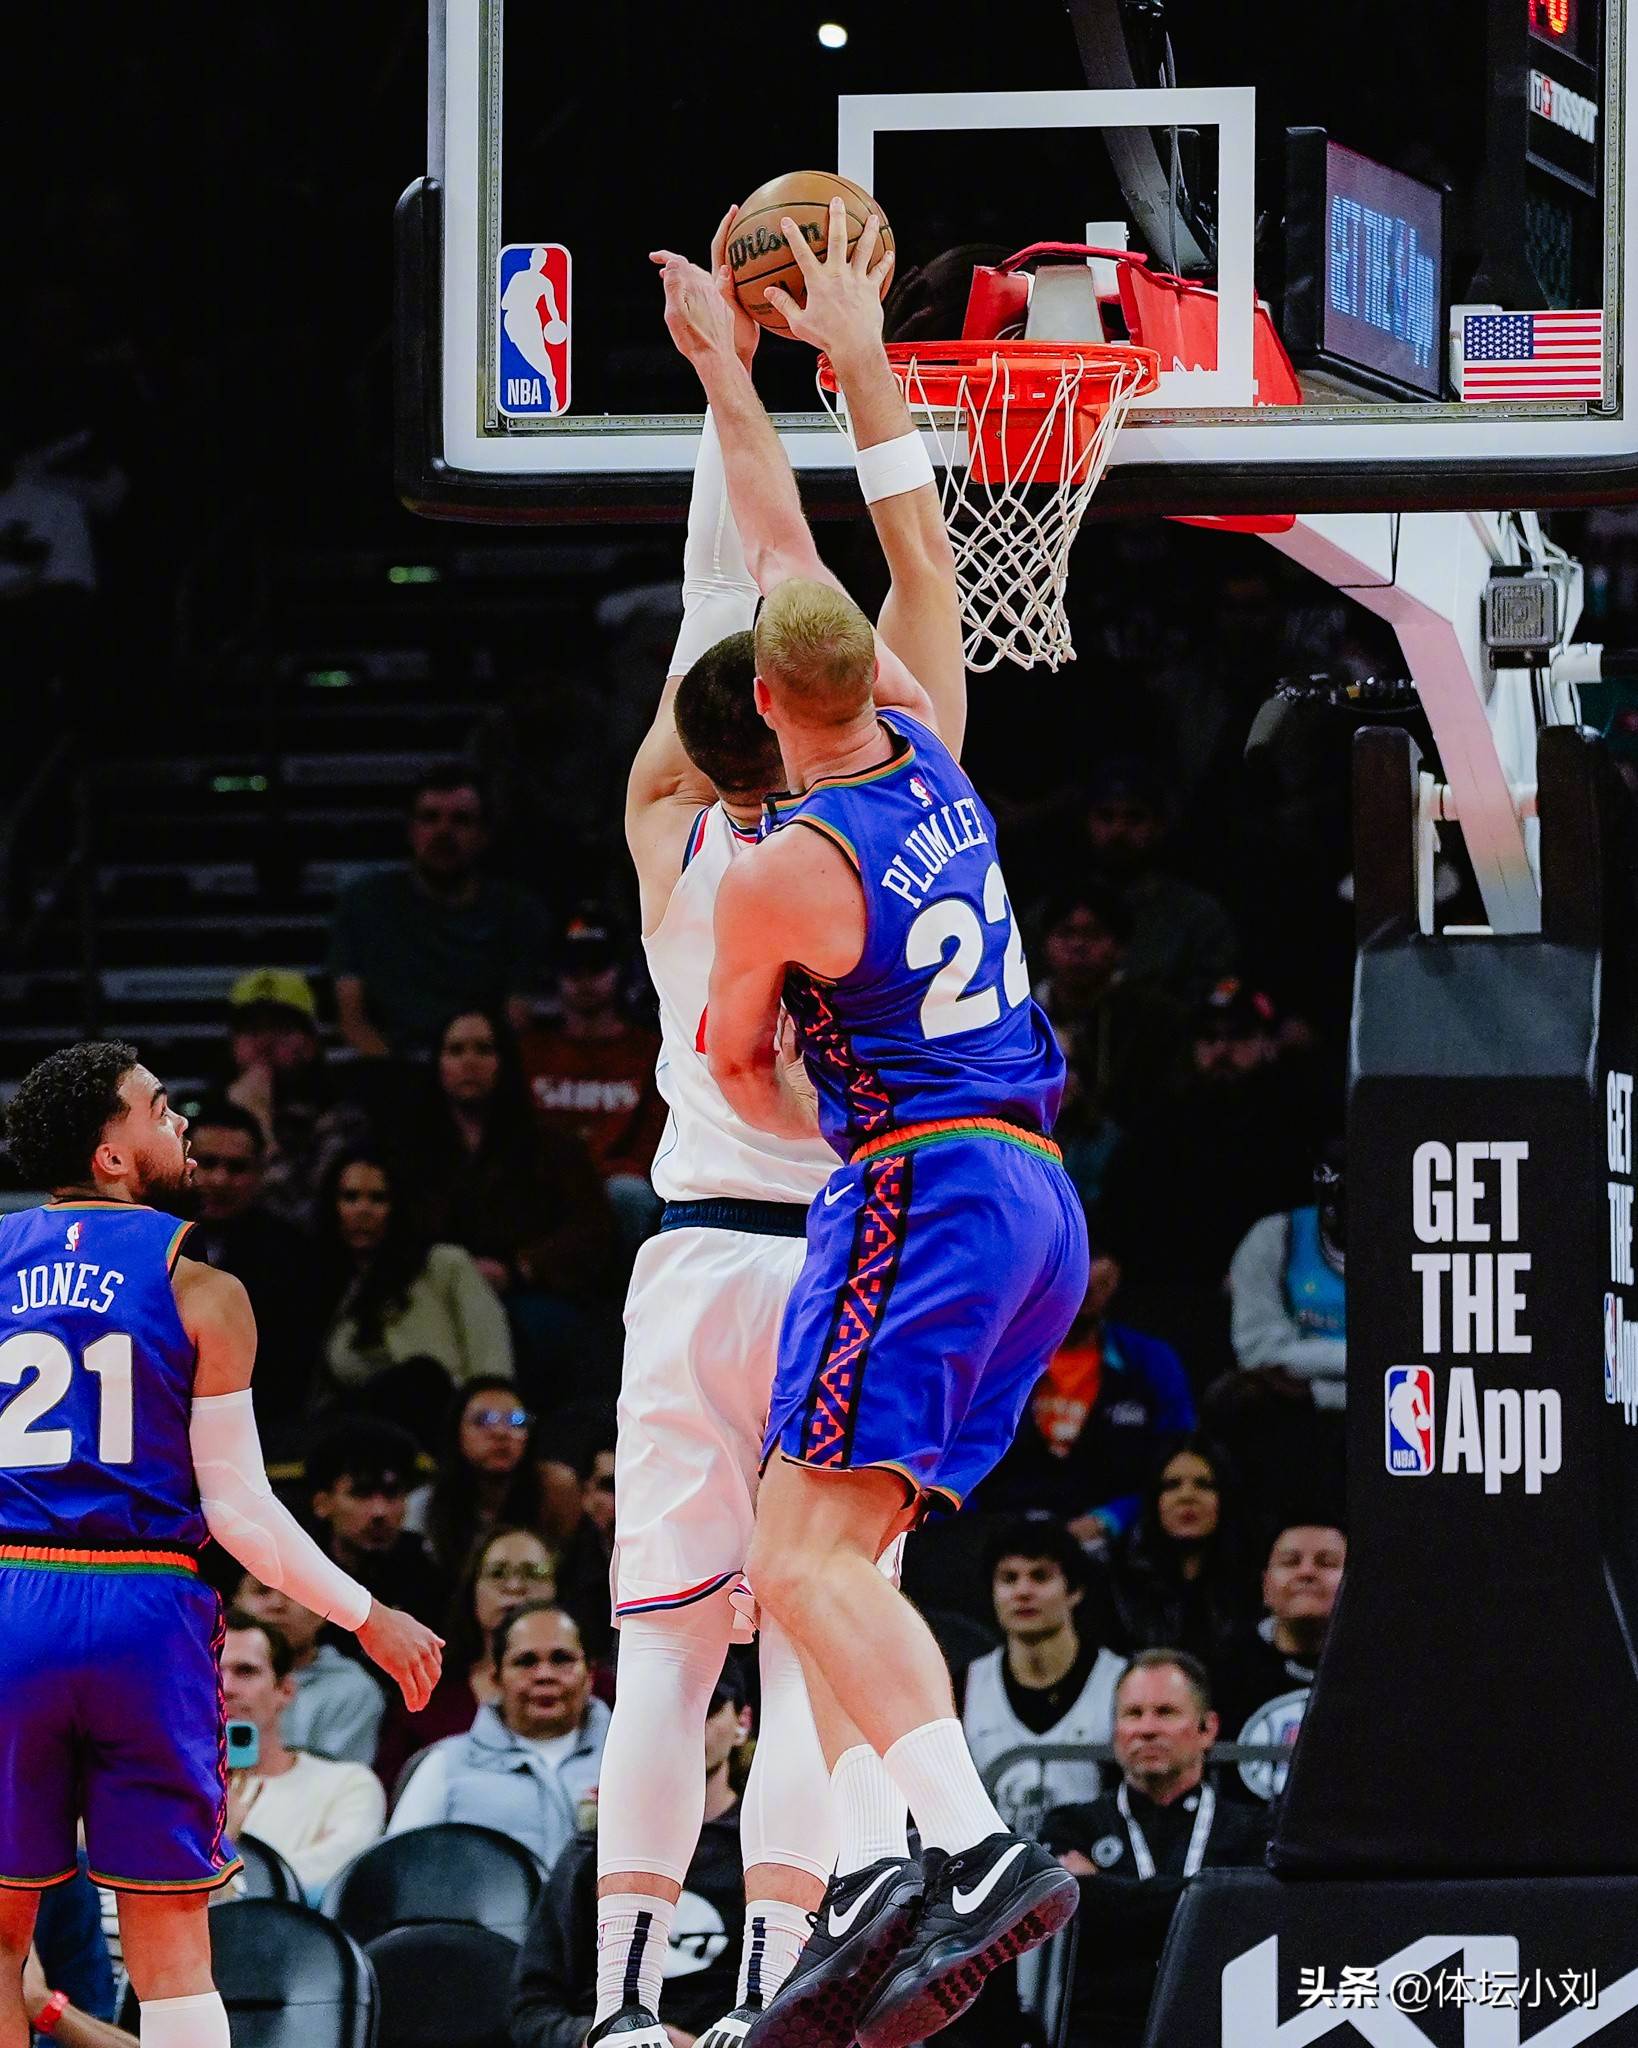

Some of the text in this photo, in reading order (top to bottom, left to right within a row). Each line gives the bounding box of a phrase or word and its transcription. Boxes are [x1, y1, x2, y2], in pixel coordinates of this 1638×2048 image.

[729, 222, 823, 271] Wilsn
[507, 378, 543, 406] NBA
[906, 861, 1031, 1040] 22
[1607, 1070, 1634, 1174] GET
[1412, 1140, 1529, 1244] GET
[1608, 1181, 1635, 1286] THE
[12, 1262, 124, 1315] JONES
[1411, 1253, 1533, 1354] THE
[0, 1331, 133, 1467] 21
[1393, 1367, 1562, 1494] NBA App
